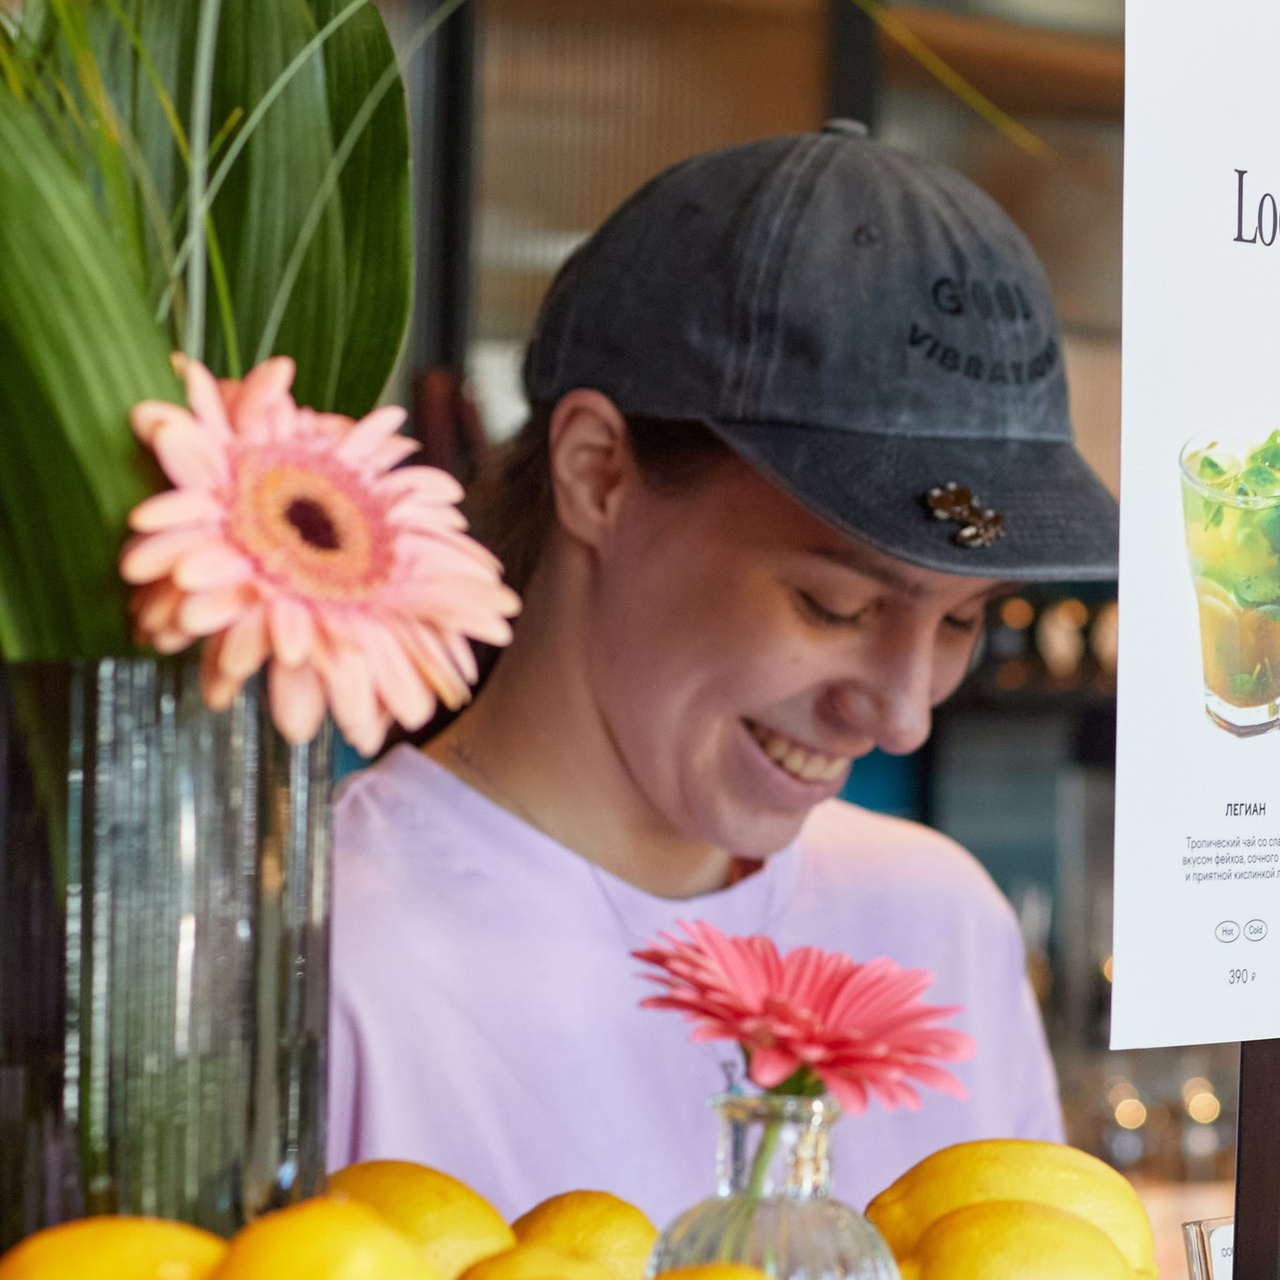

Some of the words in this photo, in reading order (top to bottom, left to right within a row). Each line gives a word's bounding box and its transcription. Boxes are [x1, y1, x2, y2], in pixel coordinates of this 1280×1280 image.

[1225, 803, 1266, 816] ЛЕГИАН
[1185, 836, 1240, 851] Тропический
[1242, 836, 1256, 847] чай
[1258, 838, 1267, 847] со
[1182, 855, 1212, 868] вкусом
[1214, 853, 1246, 867] фейхоа,
[1247, 854, 1279, 863] сочного
[1192, 869, 1232, 884] приятной
[1234, 867, 1275, 880] кислинкой
[1221, 926, 1234, 936] Hot
[1248, 925, 1263, 935] Cold
[1228, 969, 1248, 984] 390
